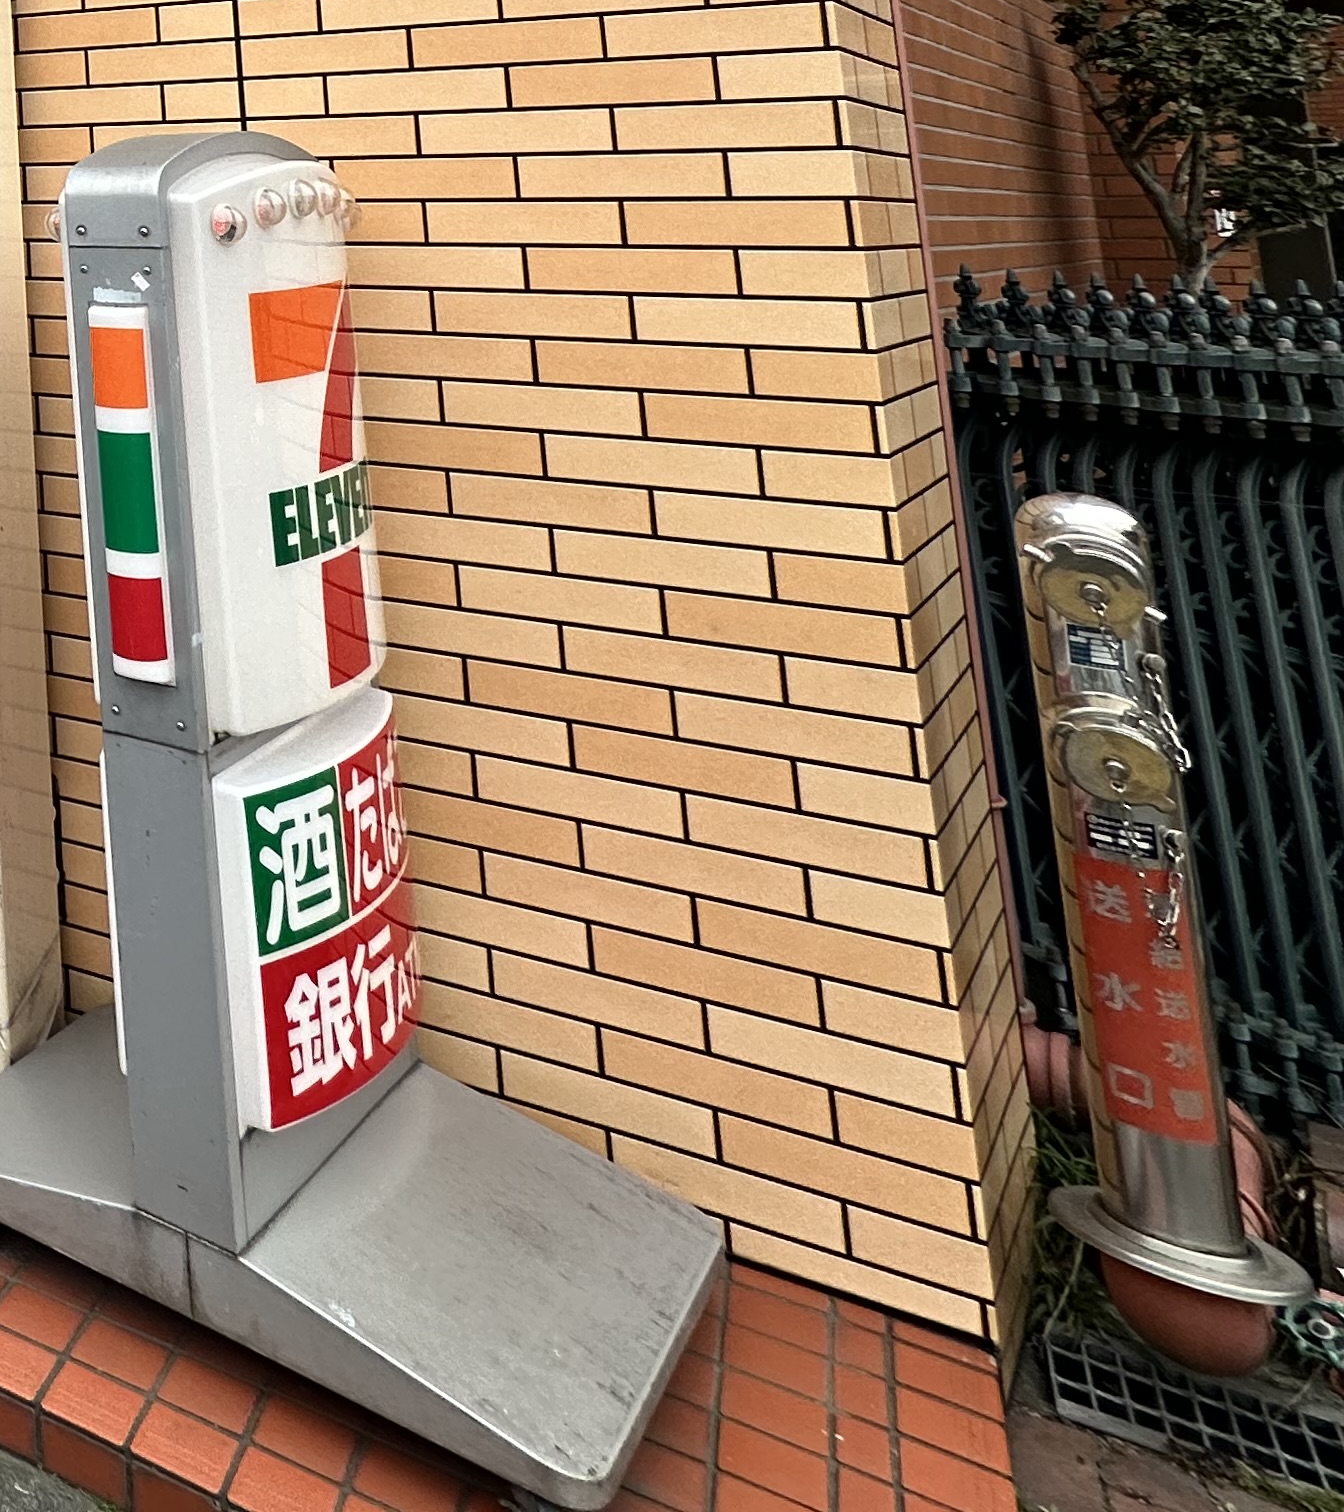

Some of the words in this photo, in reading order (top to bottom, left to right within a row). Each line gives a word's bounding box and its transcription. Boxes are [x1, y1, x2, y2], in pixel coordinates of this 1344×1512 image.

[256, 784, 341, 945] 酒
[1084, 878, 1155, 1110] 送水口
